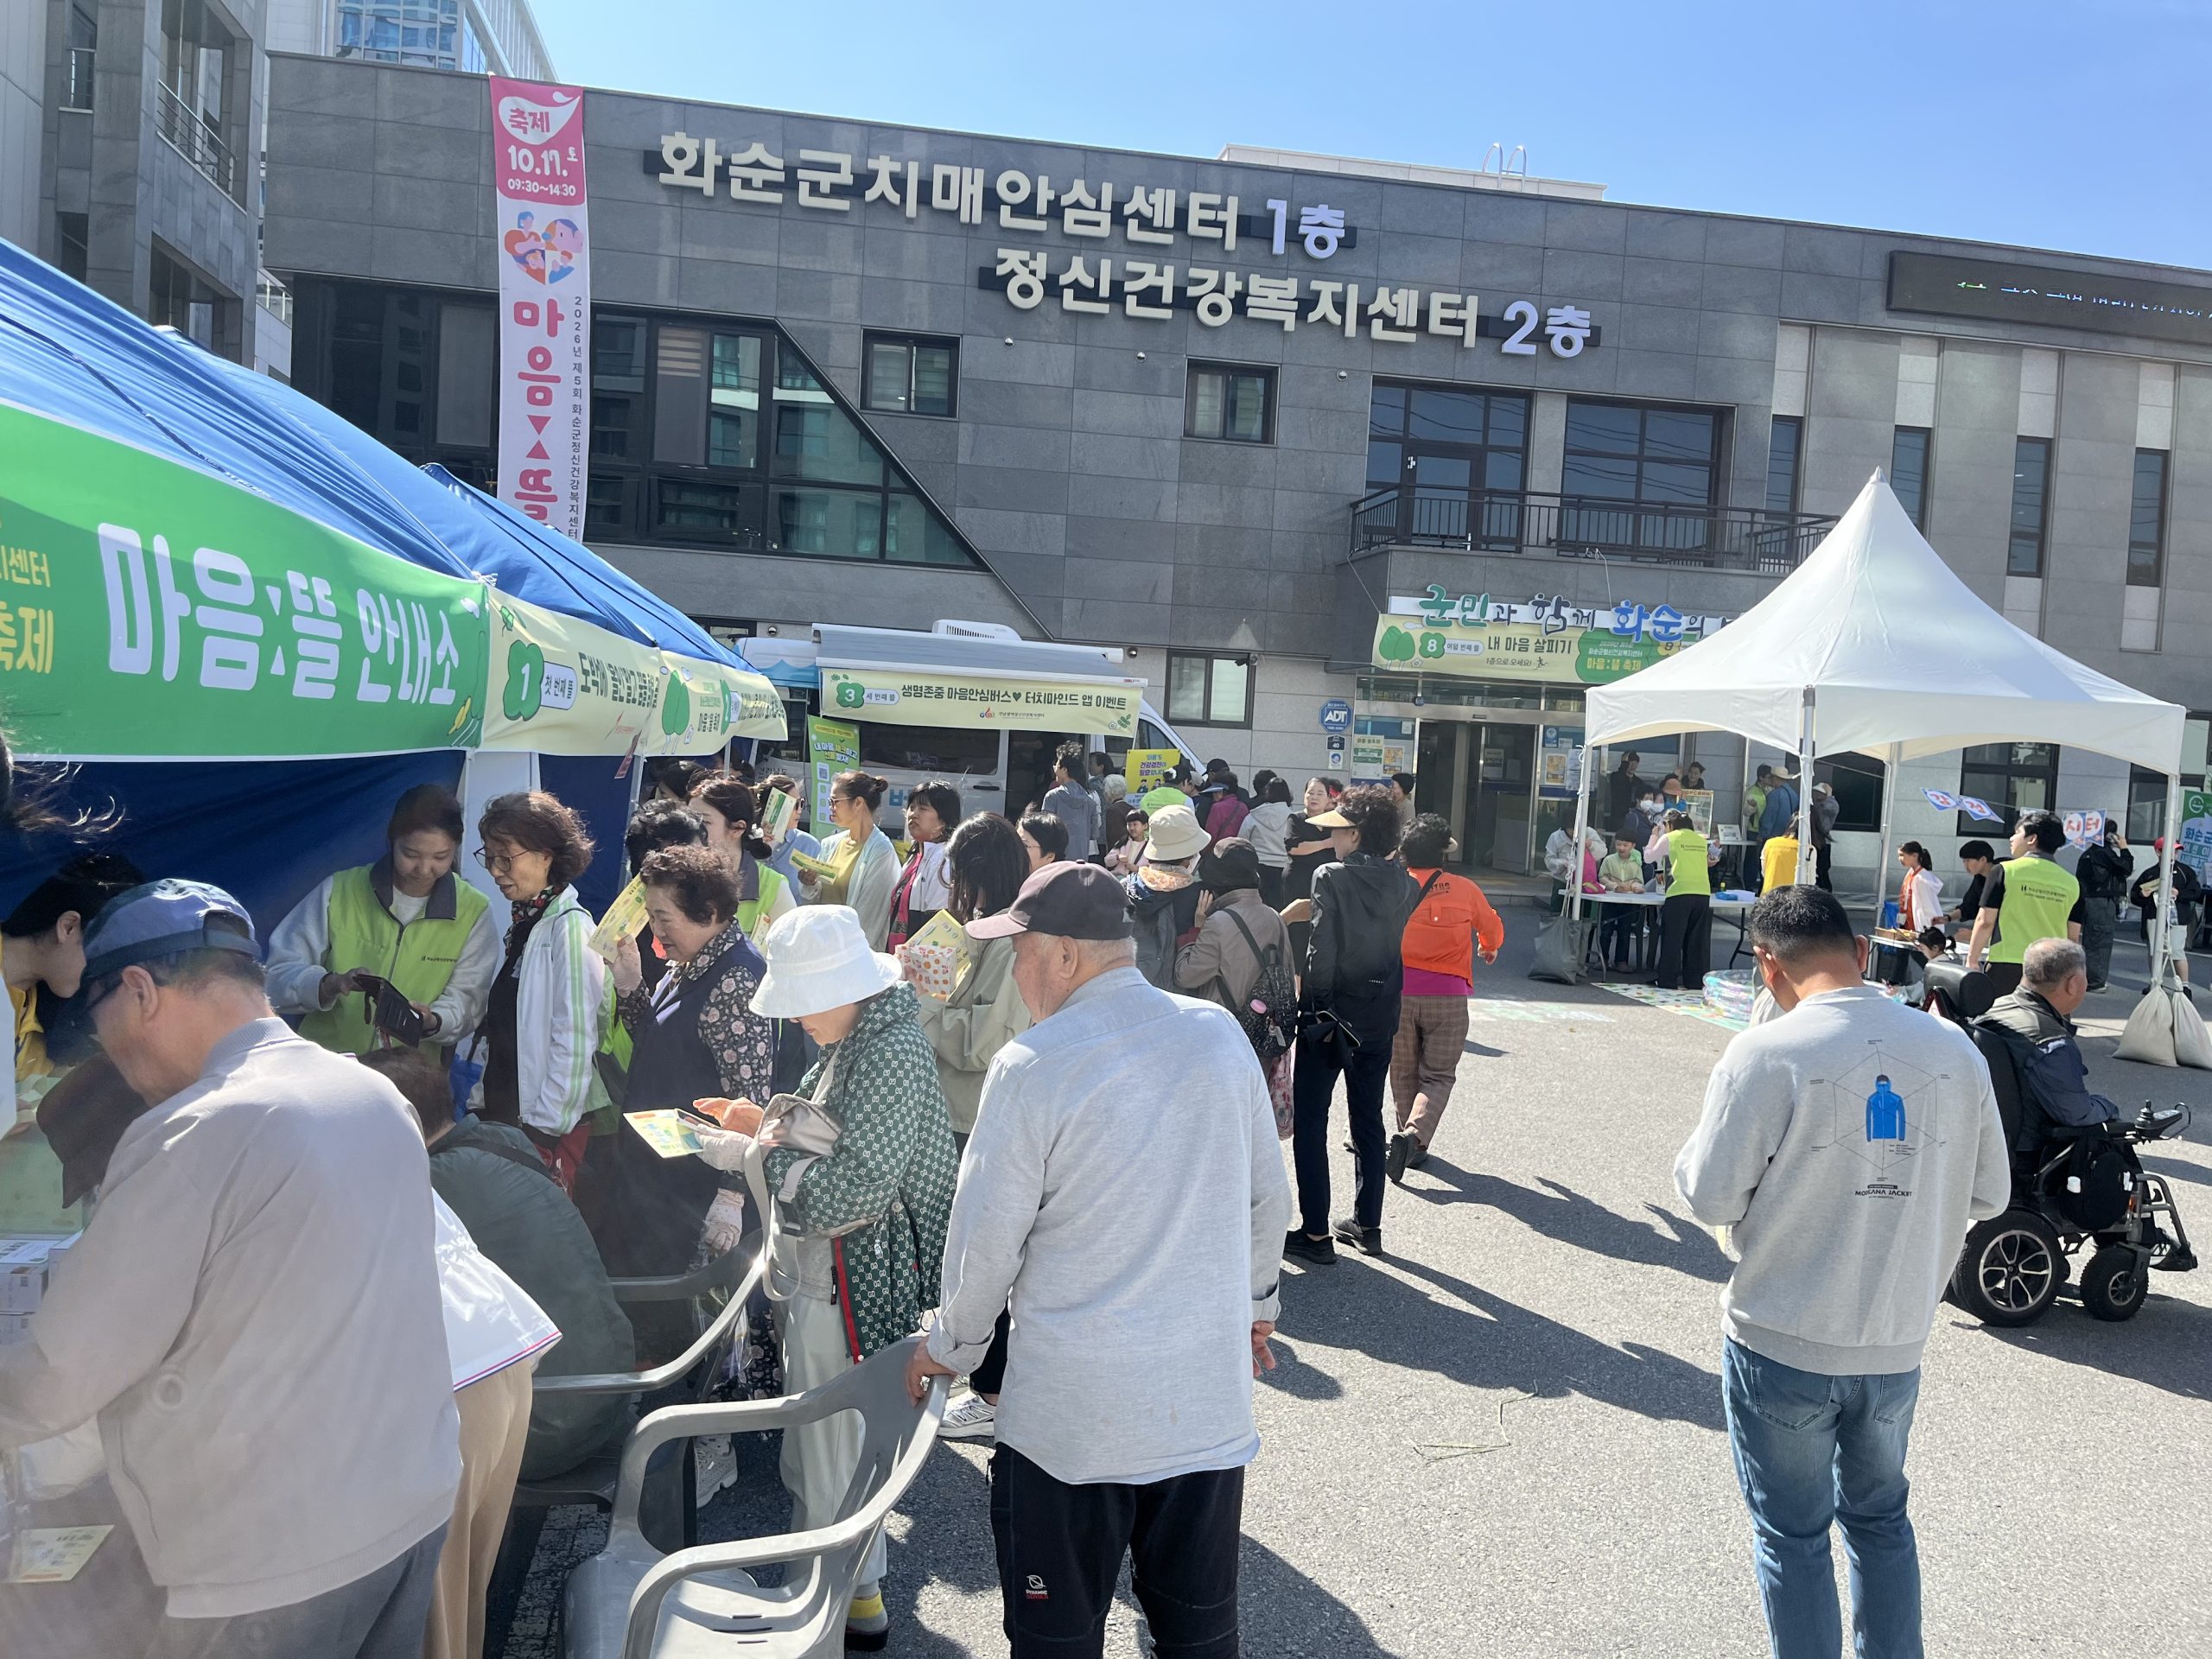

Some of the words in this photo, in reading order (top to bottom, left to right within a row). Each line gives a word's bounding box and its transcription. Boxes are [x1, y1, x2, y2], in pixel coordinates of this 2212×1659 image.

[509, 108, 550, 135] 축제
[567, 146, 579, 162] 토
[658, 131, 1238, 251] 화순군치매안심센터
[1266, 199, 1346, 260] 1층
[995, 248, 1479, 349] 정신건강복지센터
[1501, 301, 1591, 358] 2층
[573, 296, 582, 358] 2026년
[572, 361, 582, 399] 제5회
[568, 403, 582, 539] 화순군정신건강복지센터
[1419, 584, 1517, 627] 군민과
[1530, 593, 1596, 636] 함께
[1611, 600, 1705, 643] 화순의
[356, 588, 460, 705] 안내소
[1427, 639, 1437, 652] 8
[1489, 636, 1500, 651] 내
[1505, 637, 1529, 652] 마음
[1534, 638, 1572, 654] 살피기
[1664, 642, 1674, 651] 9
[1486, 657, 1509, 665] 1층으로
[1624, 659, 1641, 671] 축제
[521, 663, 530, 701] 1
[544, 674, 551, 696] 첫
[553, 674, 567, 700] 번째
[844, 689, 855, 702] 3
[901, 684, 944, 699] 생명존중
[1026, 691, 1078, 706] 터치마인드
[1082, 694, 1093, 707] 앱
[1096, 695, 1127, 710] 이벤트
[1325, 710, 1347, 722] ADT
